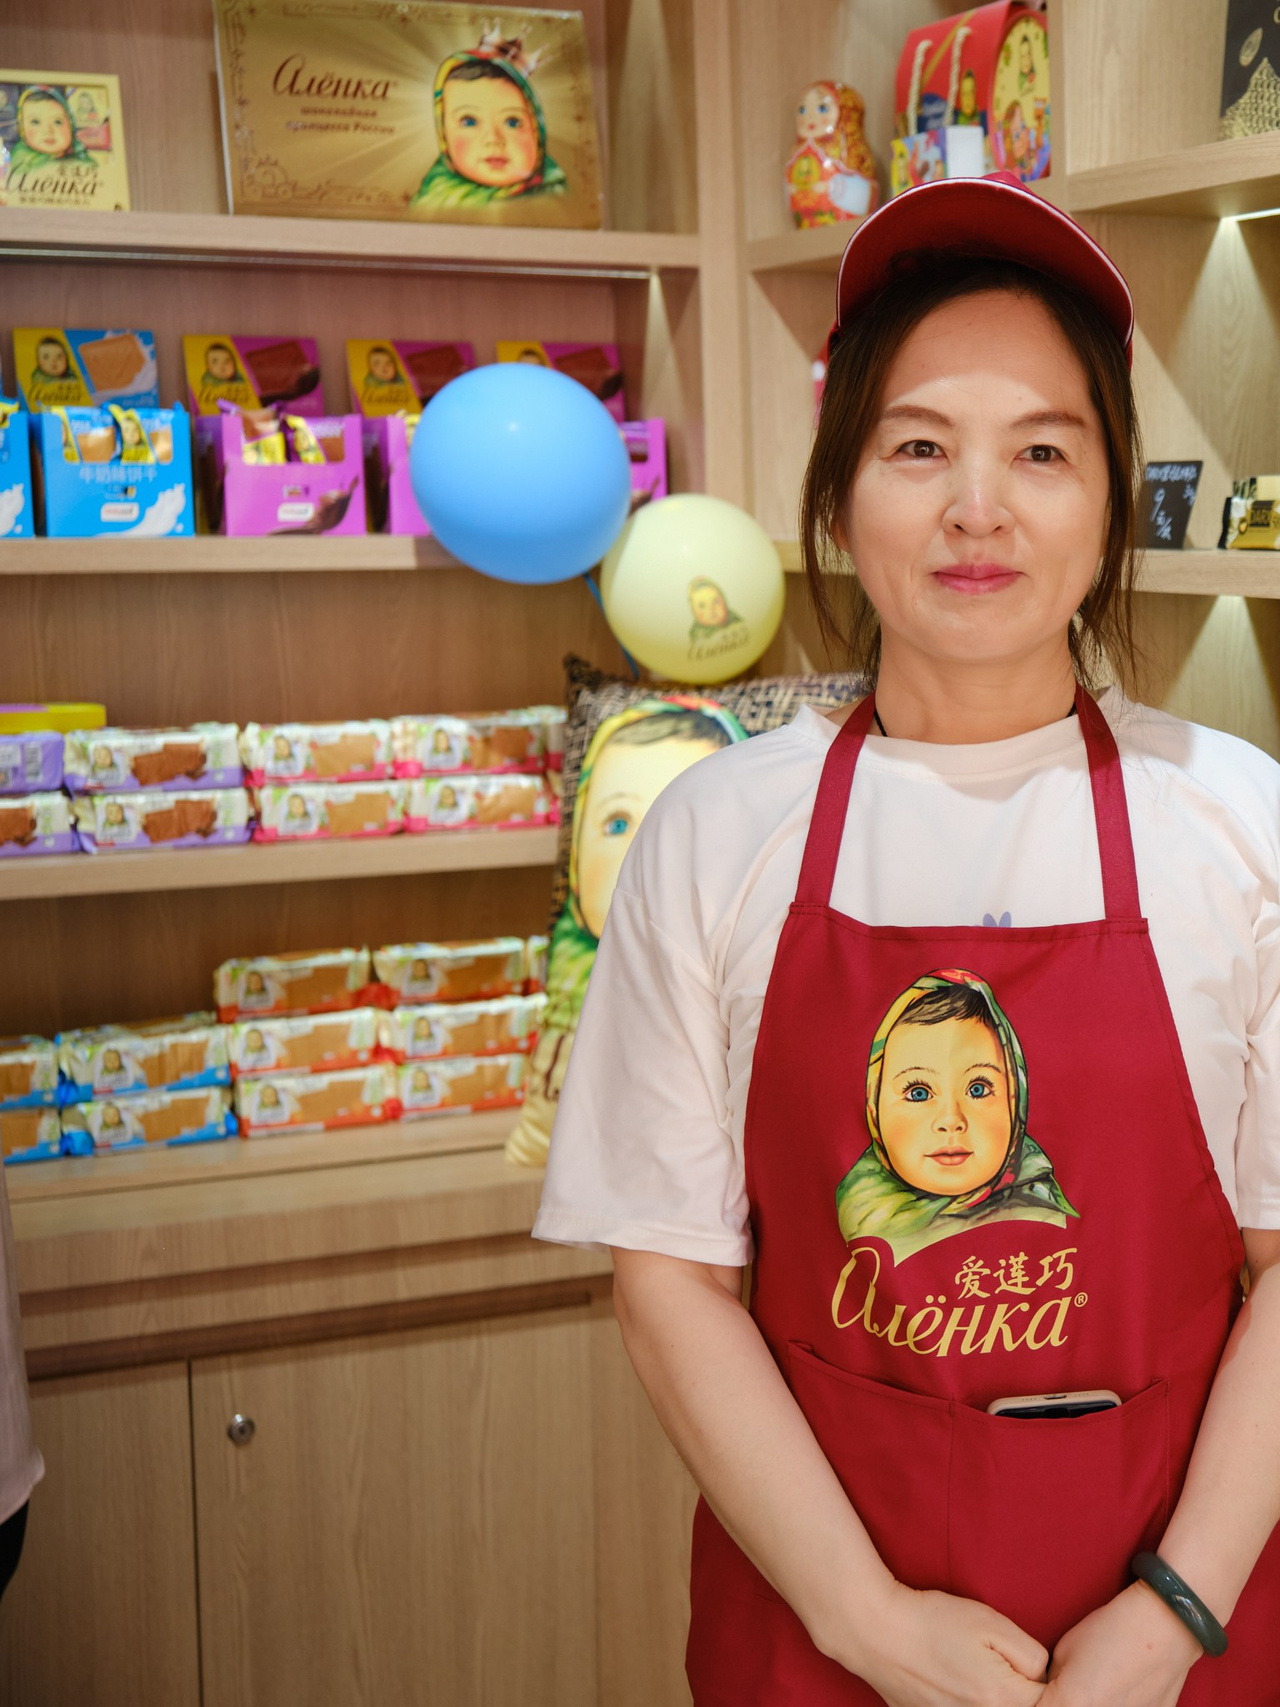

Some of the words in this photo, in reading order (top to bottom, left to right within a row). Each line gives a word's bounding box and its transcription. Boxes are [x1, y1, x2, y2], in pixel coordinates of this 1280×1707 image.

[272, 53, 390, 100] Алёнка
[954, 1247, 1078, 1300] 爱莲巧
